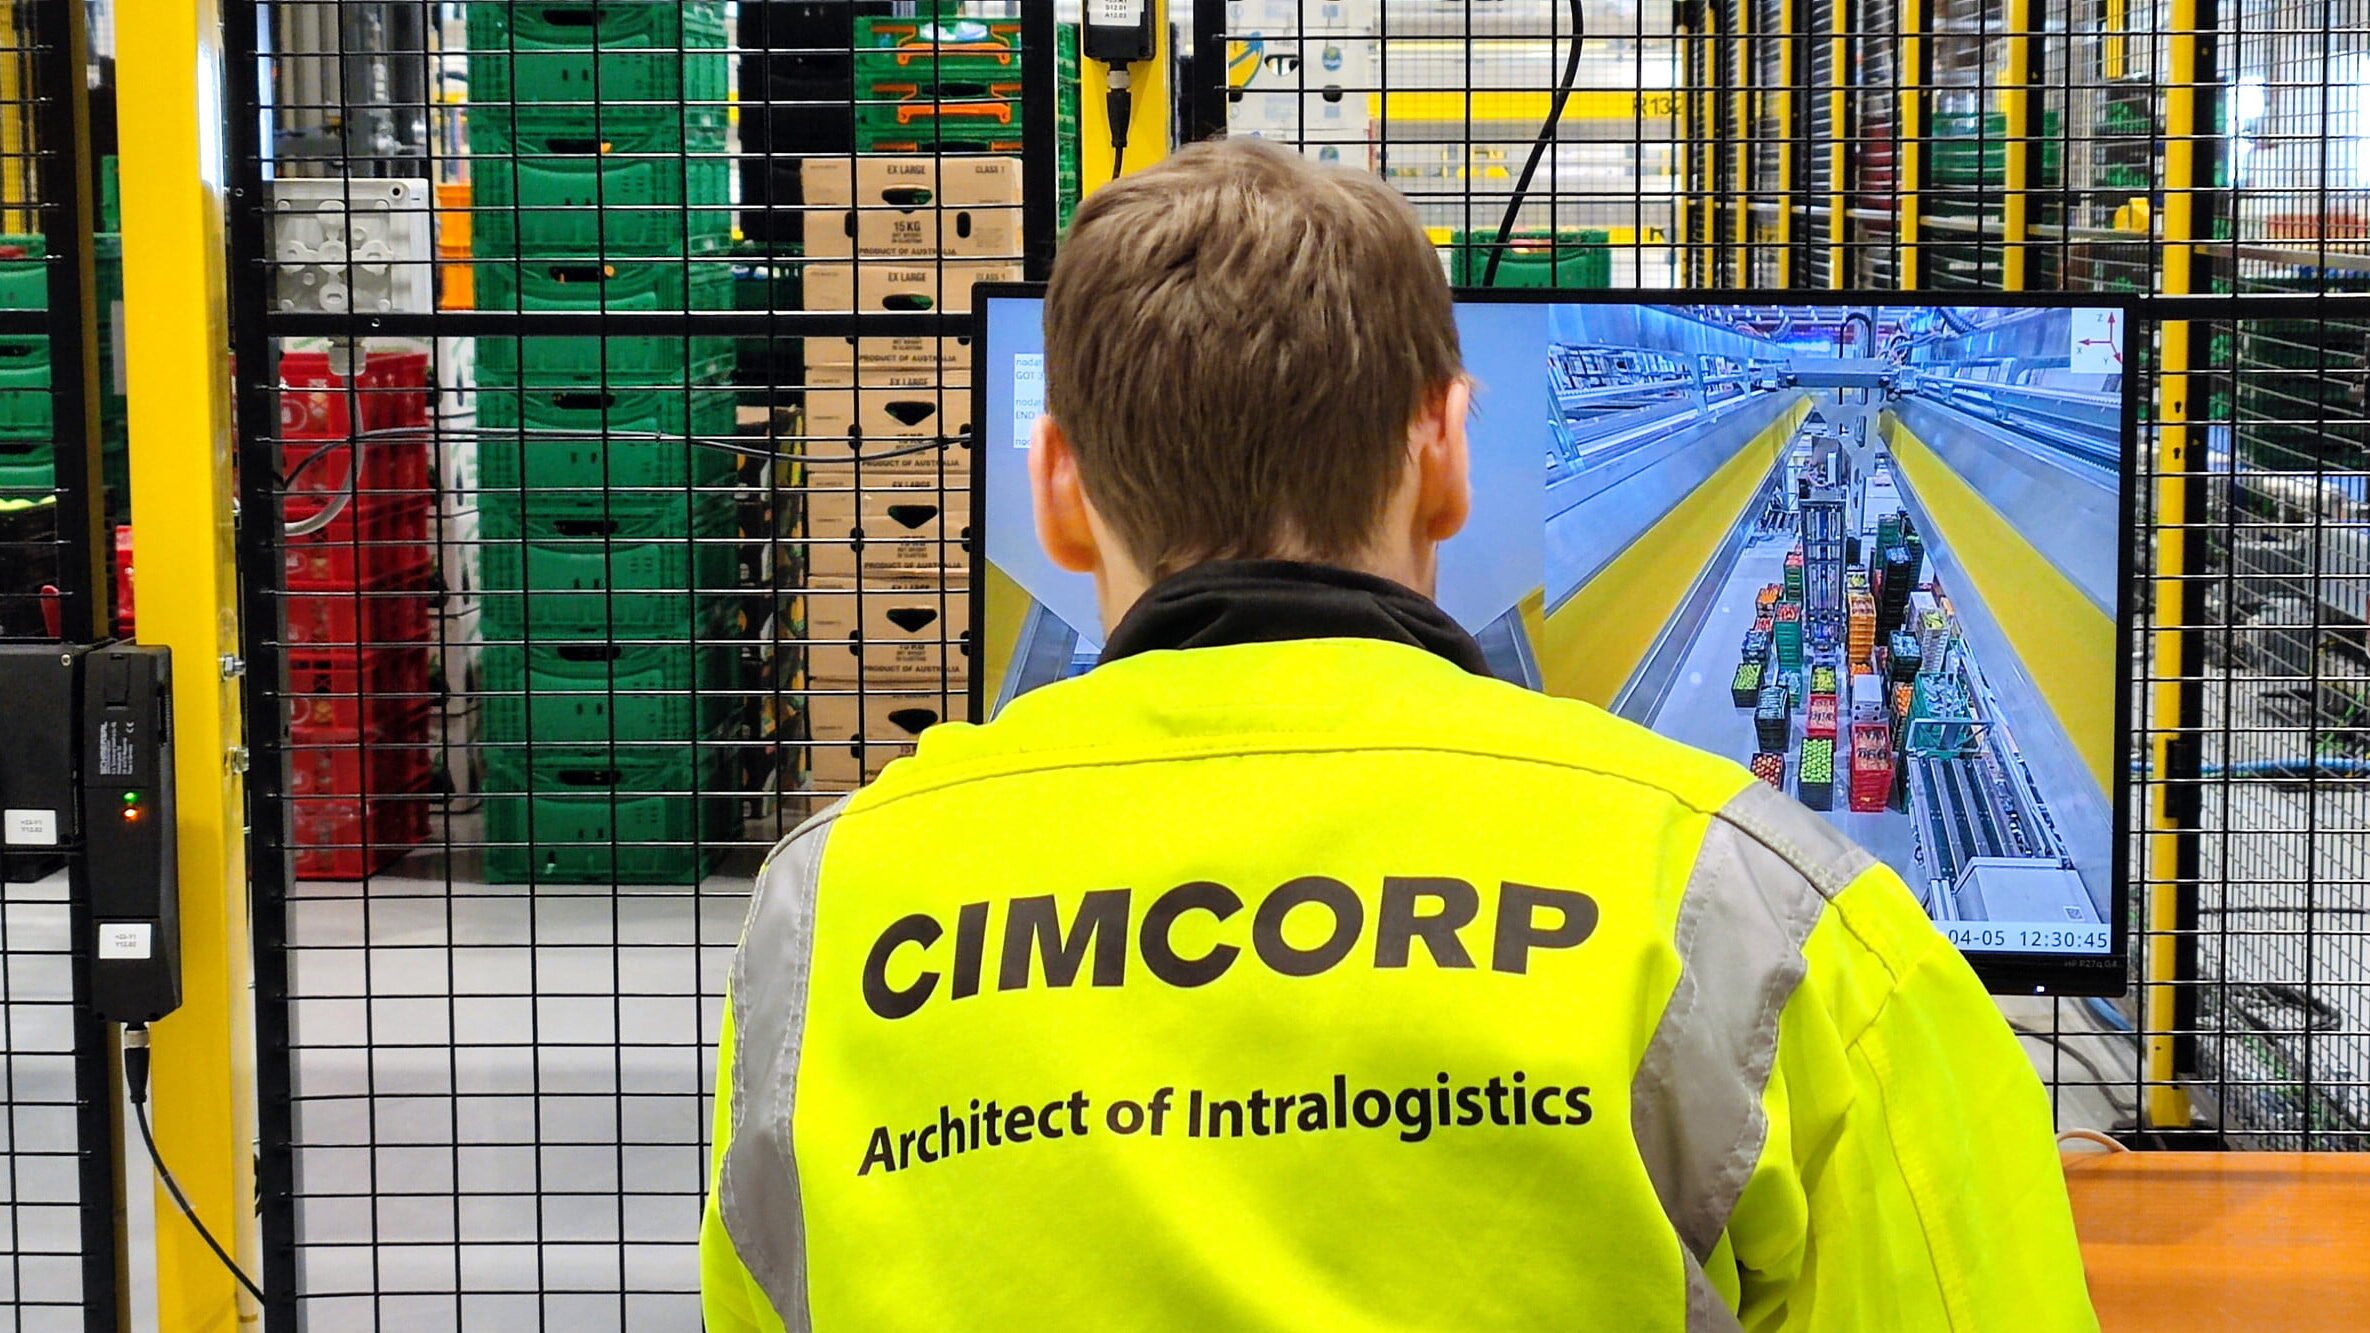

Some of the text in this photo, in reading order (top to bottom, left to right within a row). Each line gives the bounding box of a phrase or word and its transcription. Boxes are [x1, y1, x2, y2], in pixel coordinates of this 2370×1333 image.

[887, 165, 926, 174] EX LARGE
[894, 222, 921, 231] 15 KG
[888, 272, 926, 281] EX LARGE
[976, 273, 998, 281] CLASS
[901, 378, 928, 386] LARGE
[2020, 931, 2107, 949] 12:30:45
[862, 876, 1599, 1020] CIMCORP
[857, 1071, 1592, 1176] Architect of Intralogistics
